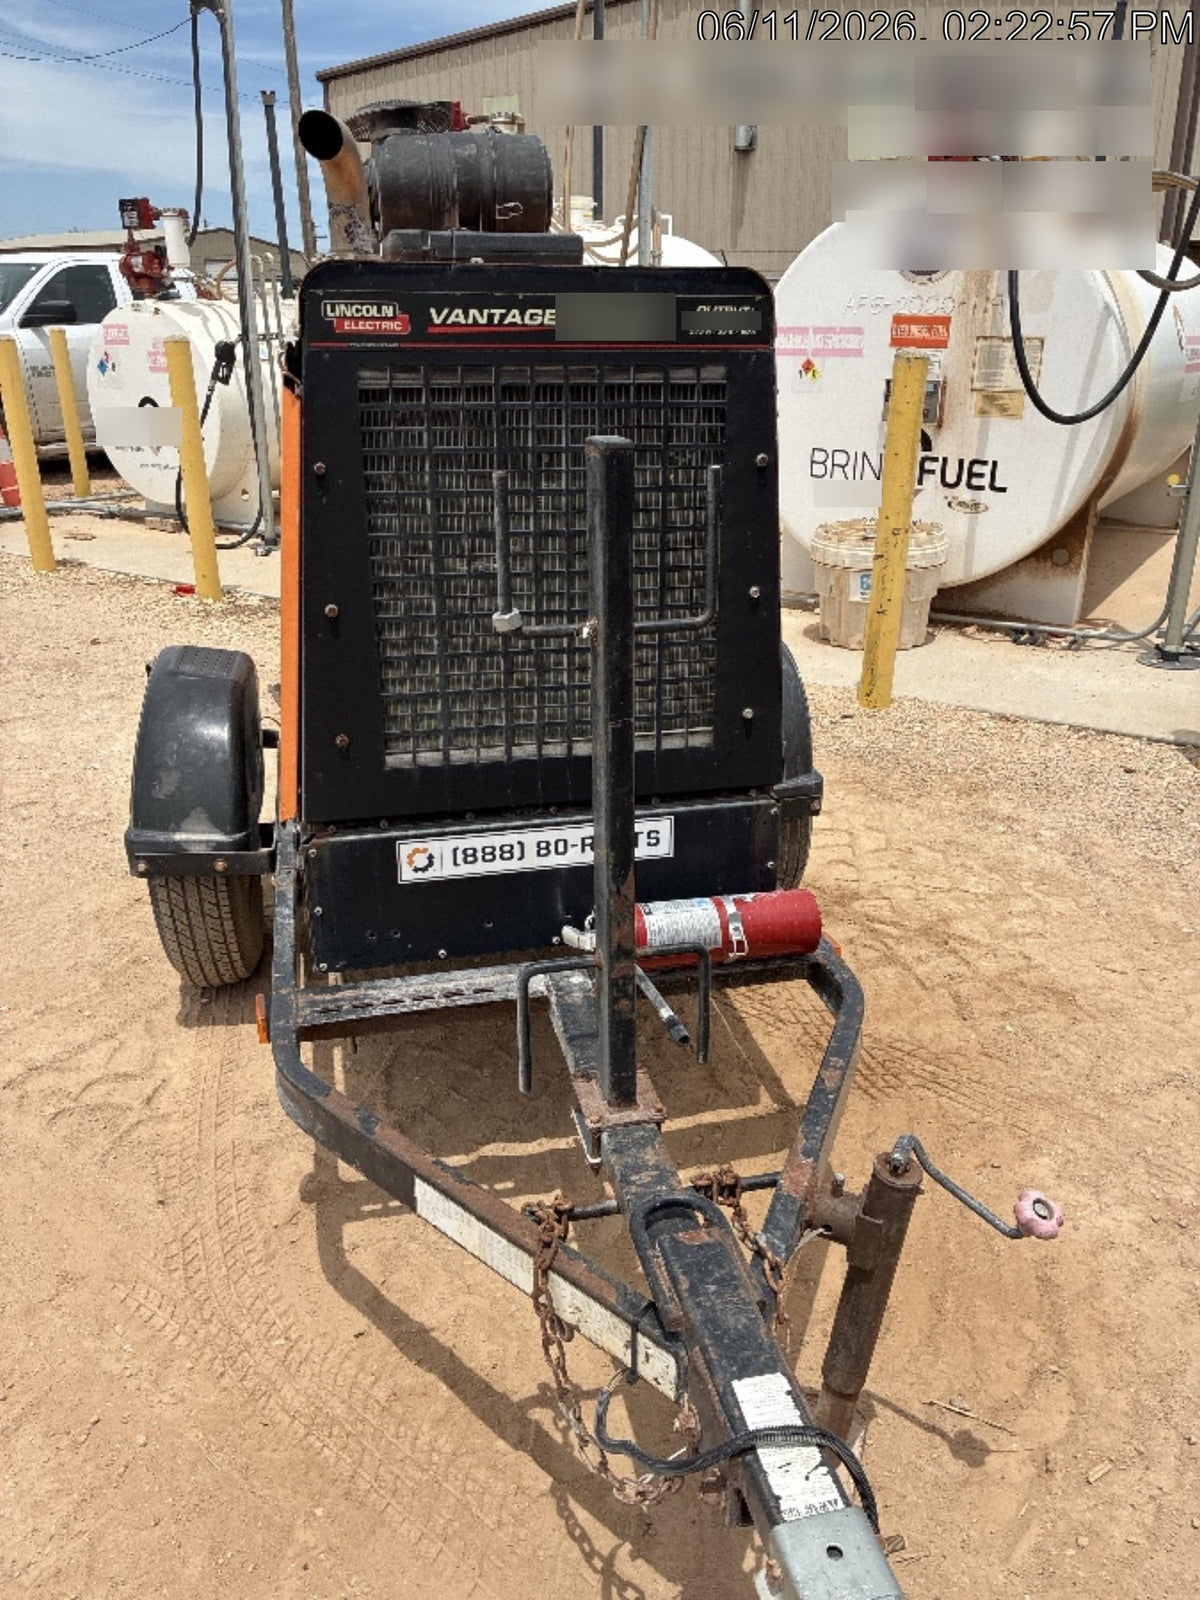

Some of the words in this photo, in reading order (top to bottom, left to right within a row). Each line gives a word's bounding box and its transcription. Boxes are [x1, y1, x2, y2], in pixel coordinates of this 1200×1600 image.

[326, 303, 394, 318] LINCOLN
[429, 307, 556, 326] VANTAGE
[344, 321, 403, 331] ELECTRIC
[810, 447, 883, 481] BRIN
[917, 455, 1008, 493] FUEL
[452, 840, 525, 867] (888)
[536, 829, 661, 858] 80-RTS
